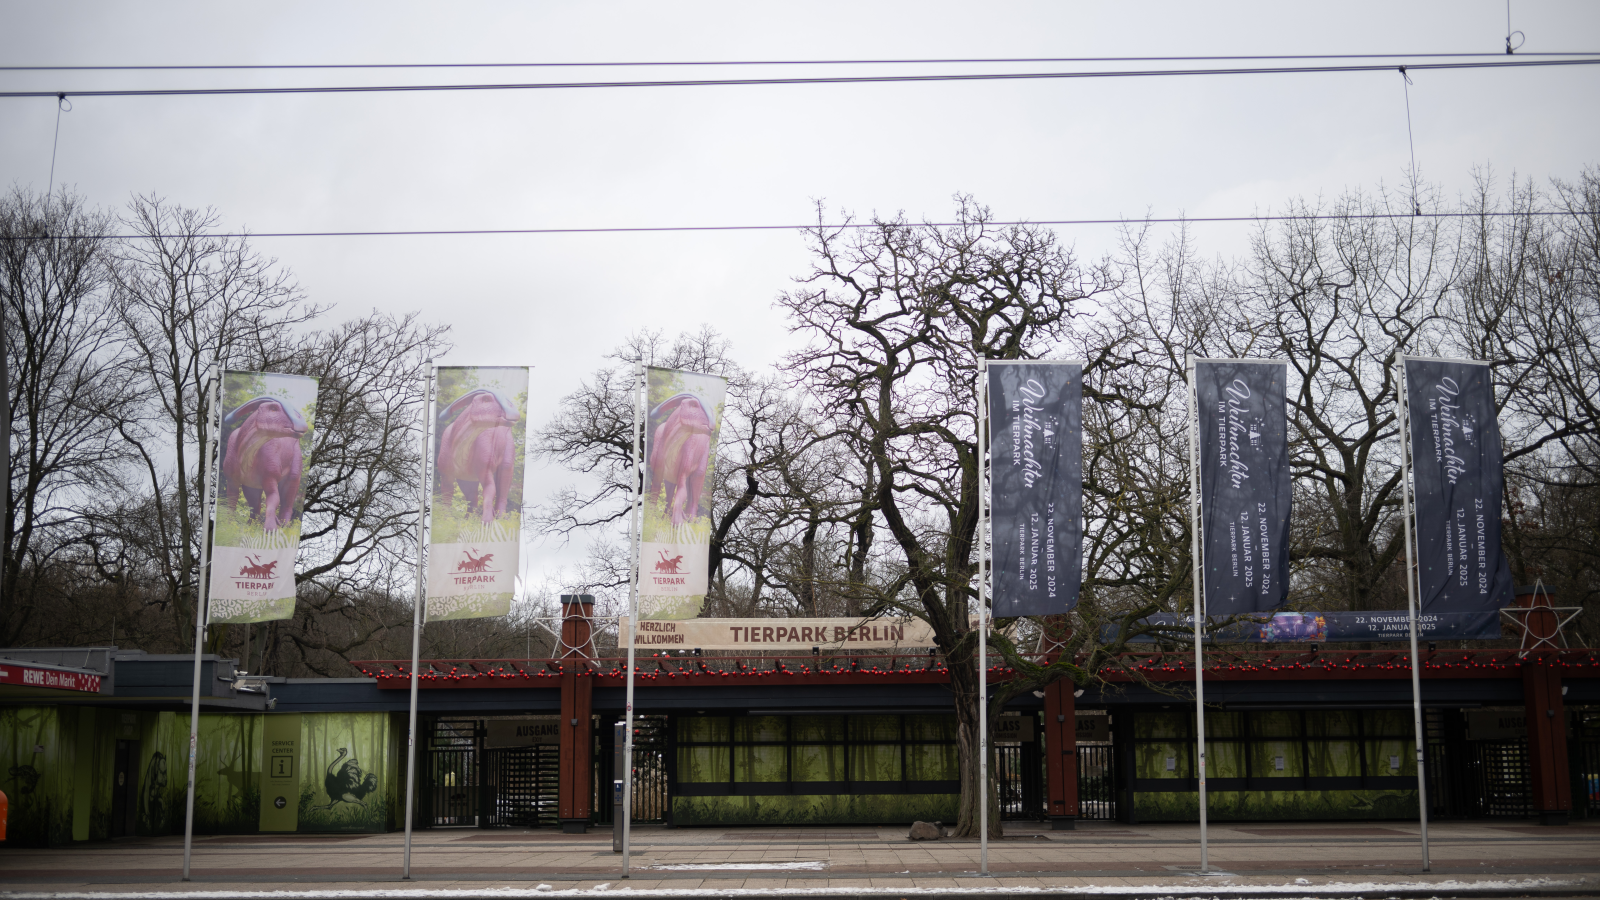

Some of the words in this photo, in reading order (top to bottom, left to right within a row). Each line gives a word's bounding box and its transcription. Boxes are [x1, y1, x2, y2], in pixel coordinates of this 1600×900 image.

[1012, 400, 1020, 412] IM
[1218, 401, 1226, 412] IM
[1428, 398, 1436, 410] IM
[1012, 415, 1020, 466] TIERPARK
[1020, 379, 1045, 488] Weihnachten
[1218, 416, 1227, 467] TIERPARK
[1226, 379, 1251, 489] Weihnachten
[1430, 413, 1442, 463] TIERPARK
[1436, 376, 1466, 485] Weihnachten
[1258, 502, 1266, 516] 22.
[1456, 508, 1465, 522] 12.
[1474, 498, 1483, 512] 22.
[1031, 512, 1039, 526] 12.
[1240, 511, 1249, 524] 12.
[1030, 528, 1039, 566] JANUAR
[1046, 518, 1055, 572] NOVEMBER
[1242, 525, 1252, 562] JANUAR
[1260, 517, 1270, 570] NOVEMBER
[1458, 524, 1468, 561] JANUAR
[1476, 514, 1486, 569] NOVEMBER
[454, 575, 496, 585] TIERPARK
[653, 576, 686, 585] TIERPARK
[1030, 568, 1038, 590] 2025
[1244, 565, 1253, 588] 2025
[1262, 573, 1270, 595] 2024
[1460, 564, 1468, 586] 2025
[1478, 572, 1488, 594] 2024
[1048, 575, 1056, 598] 2024
[640, 622, 676, 632] HERZLICH
[1370, 616, 1411, 624] NOVEMBE
[634, 634, 684, 644] WILLKOMMEN
[730, 626, 828, 642] TIERPARK
[834, 626, 904, 642] BERLIN
[24, 669, 44, 684] REWE
[46, 672, 58, 686] Dein
[58, 674, 76, 688] Markt
[516, 724, 558, 737] AUSGANG
